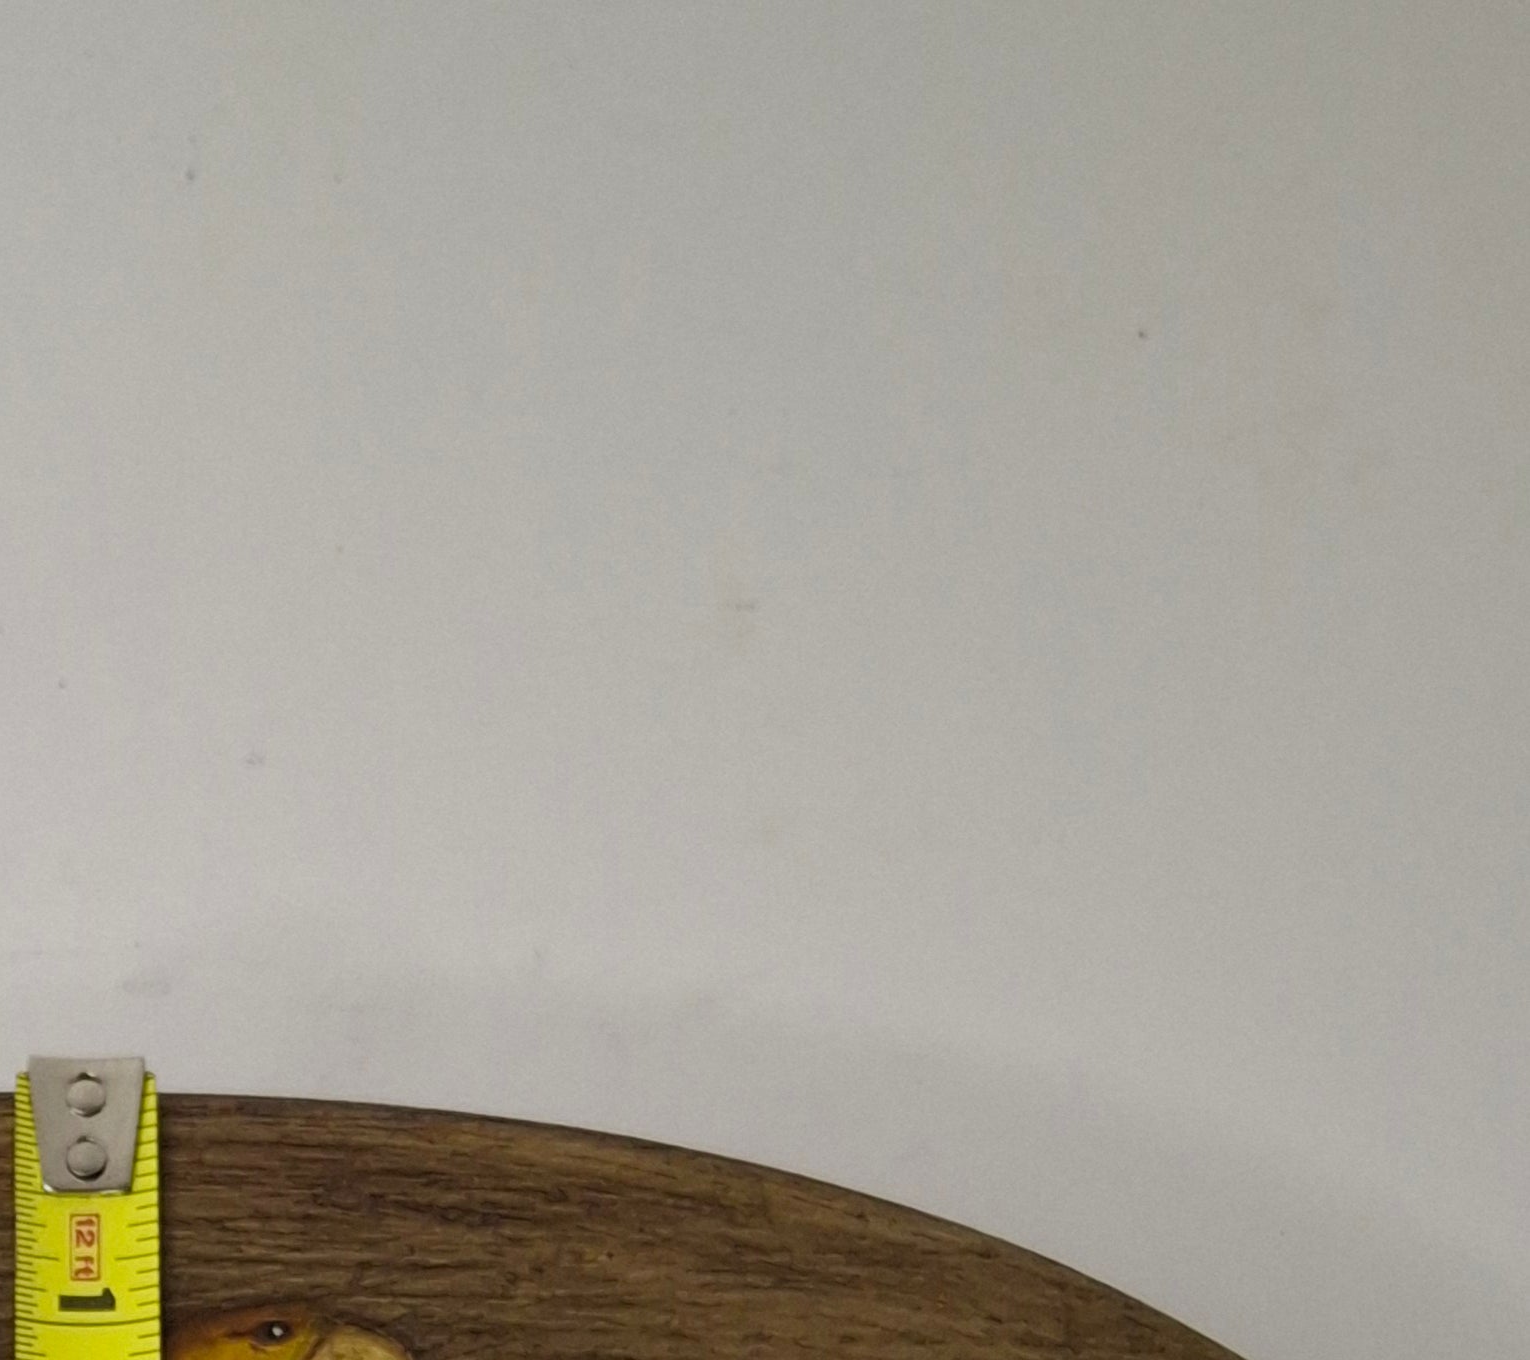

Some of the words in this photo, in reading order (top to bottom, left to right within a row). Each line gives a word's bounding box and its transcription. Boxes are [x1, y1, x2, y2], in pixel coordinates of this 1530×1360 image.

[74, 1218, 96, 1248] 12
[74, 1256, 95, 1277] ft
[58, 1287, 116, 1313] 1
